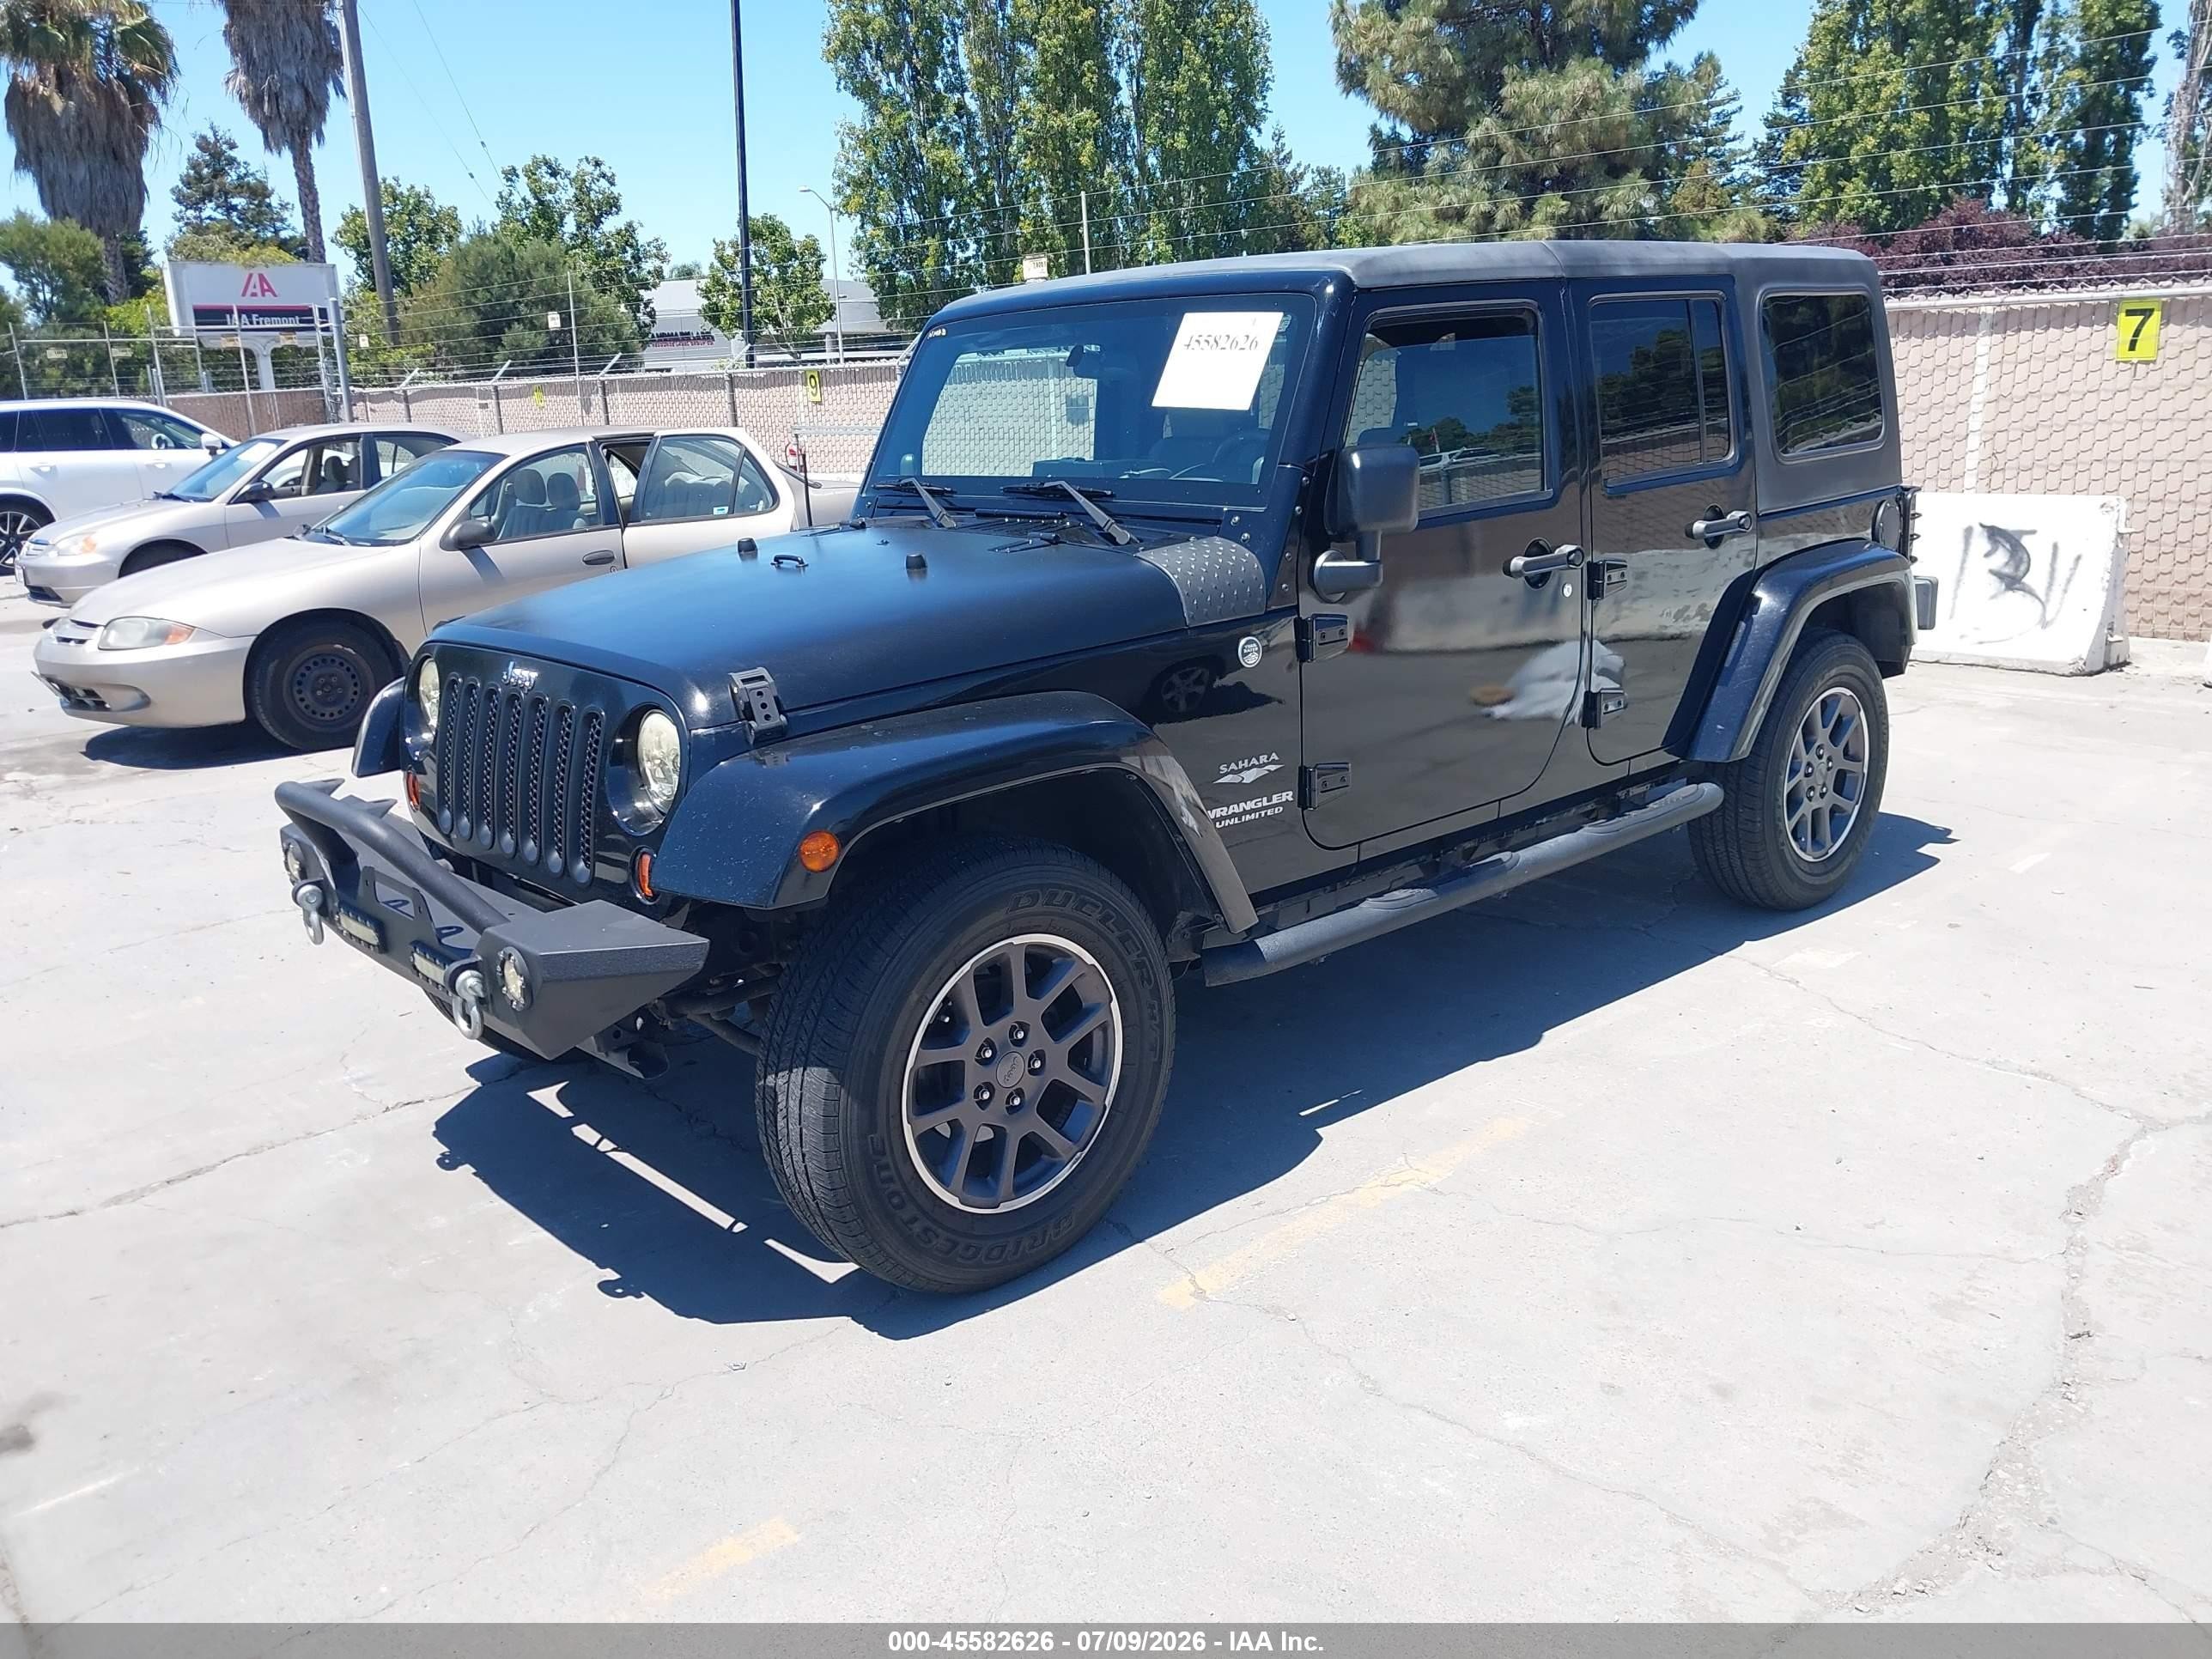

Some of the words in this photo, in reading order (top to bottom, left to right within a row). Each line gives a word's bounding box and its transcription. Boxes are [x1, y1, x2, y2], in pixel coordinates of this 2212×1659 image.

[226, 313, 249, 326] IAA
[252, 314, 301, 326] Fremont
[2124, 307, 2155, 352] 7
[1183, 334, 1259, 351] 45582626
[808, 374, 818, 398] 9
[1219, 752, 1279, 775] SAHARA
[1215, 806, 1284, 830] UNLIMITED
[1006, 888, 1156, 989] DUELER
[867, 1133, 1075, 1265] BRIDGESTONE
